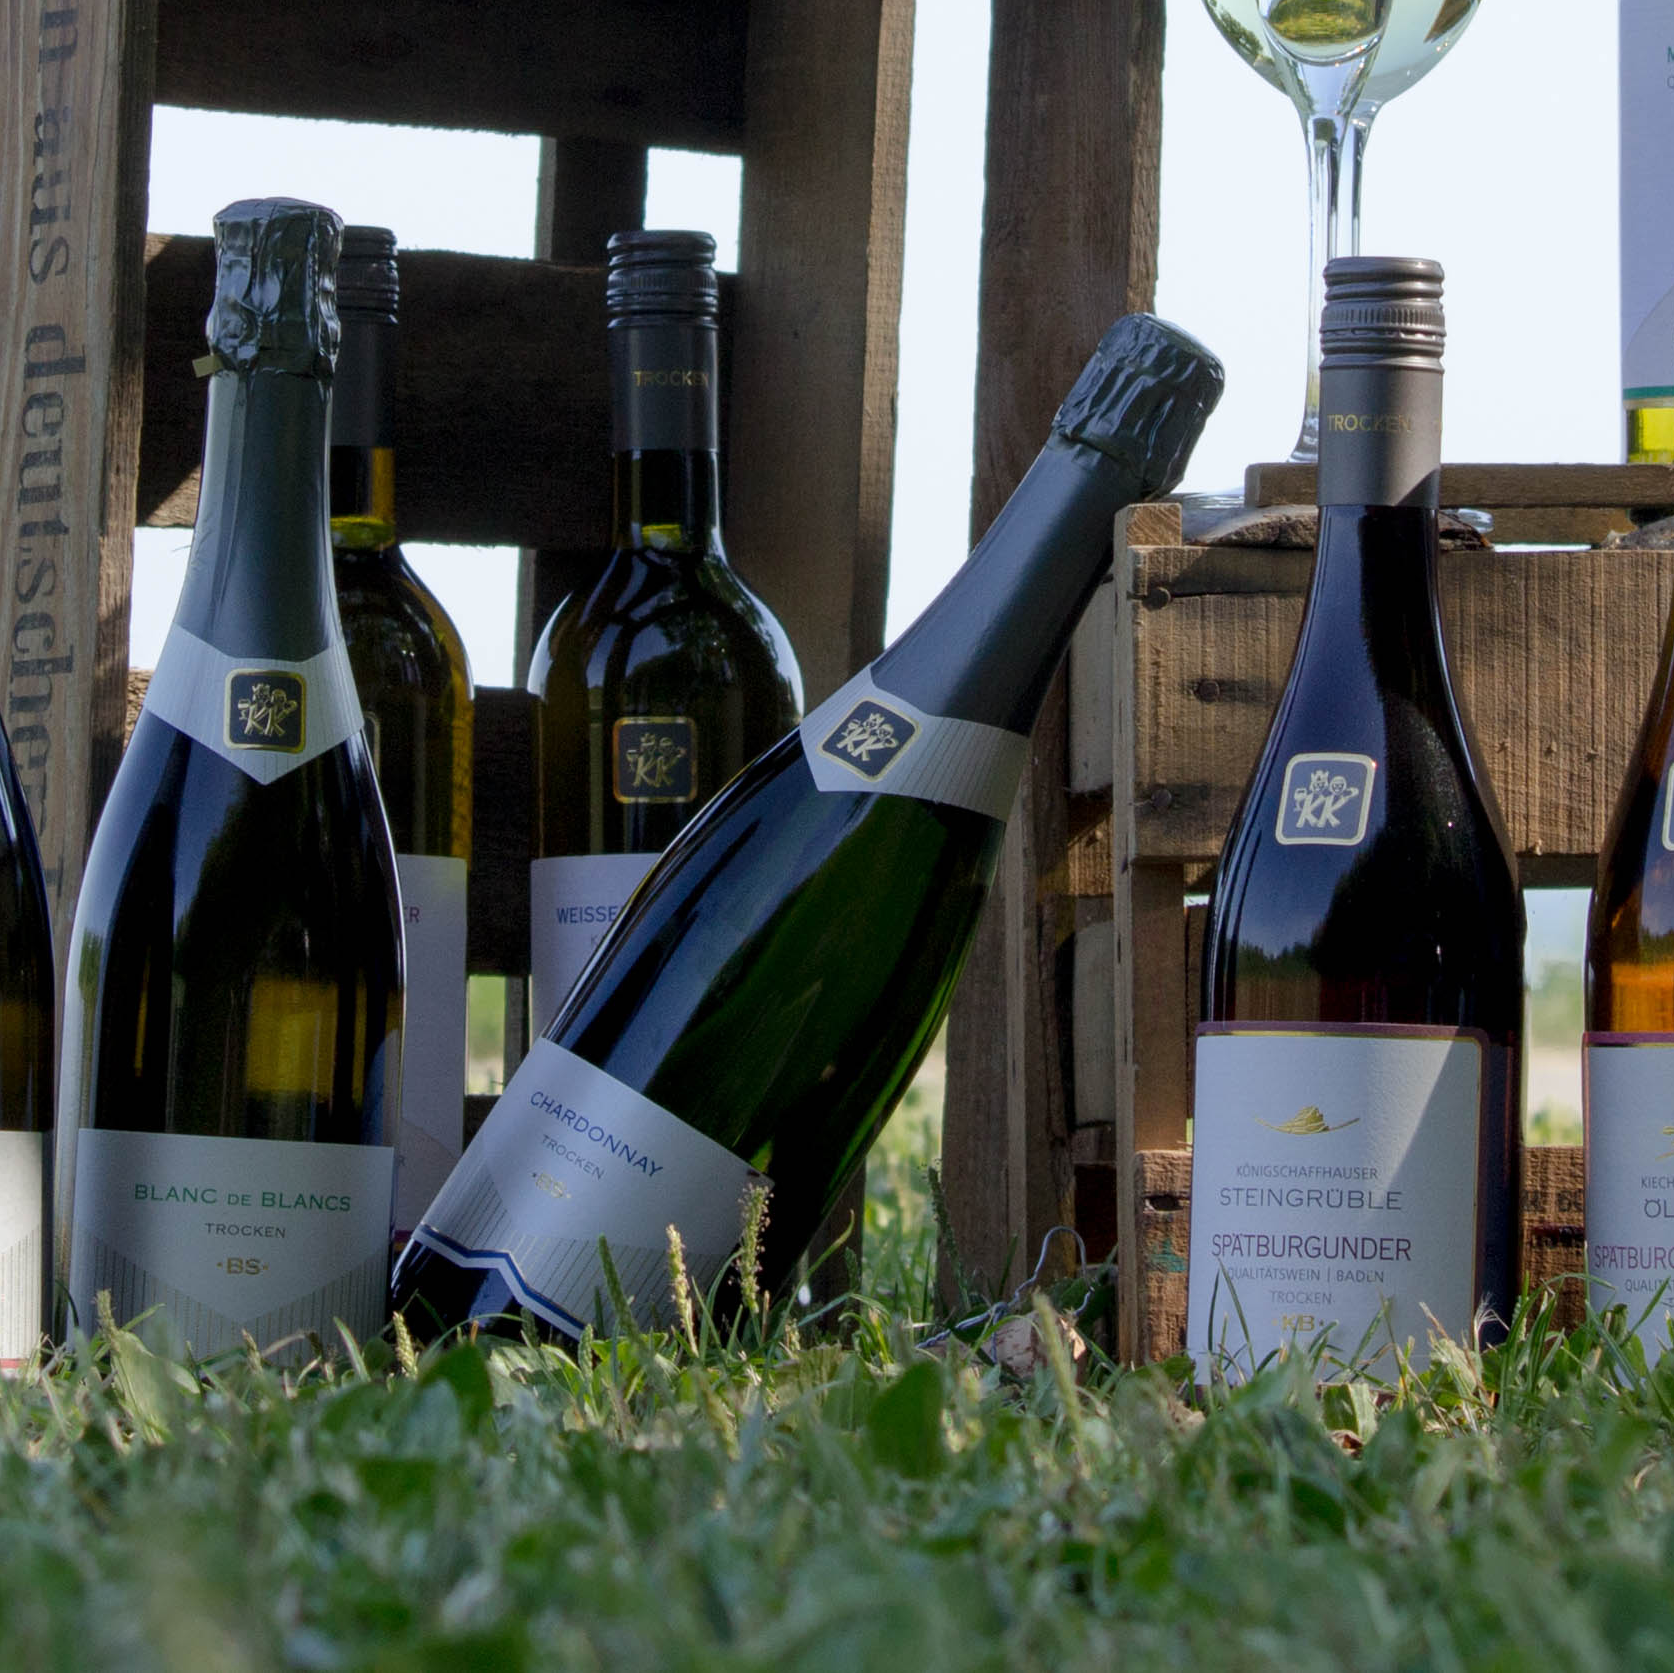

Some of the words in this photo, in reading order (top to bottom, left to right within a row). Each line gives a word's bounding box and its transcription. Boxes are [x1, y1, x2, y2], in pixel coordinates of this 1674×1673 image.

[631, 370, 710, 388] TROCKEN
[1327, 413, 1412, 433] TROCKEN
[530, 1091, 663, 1177] CHARDONNAY
[541, 1134, 605, 1180] TROCKEN
[1236, 1162, 1378, 1180] KÖNIGSCHAFFHAUSER
[134, 1183, 218, 1205] BLANC
[227, 1193, 253, 1207] DE
[261, 1191, 352, 1213] BLANCS
[1219, 1186, 1403, 1211] STEINGRÜBLE
[204, 1222, 286, 1239] TROCKEN
[1211, 1233, 1413, 1262] SPÄTBURGUNDER
[1336, 1269, 1385, 1284] BADEN
[1270, 1289, 1333, 1305] TROCKEN
